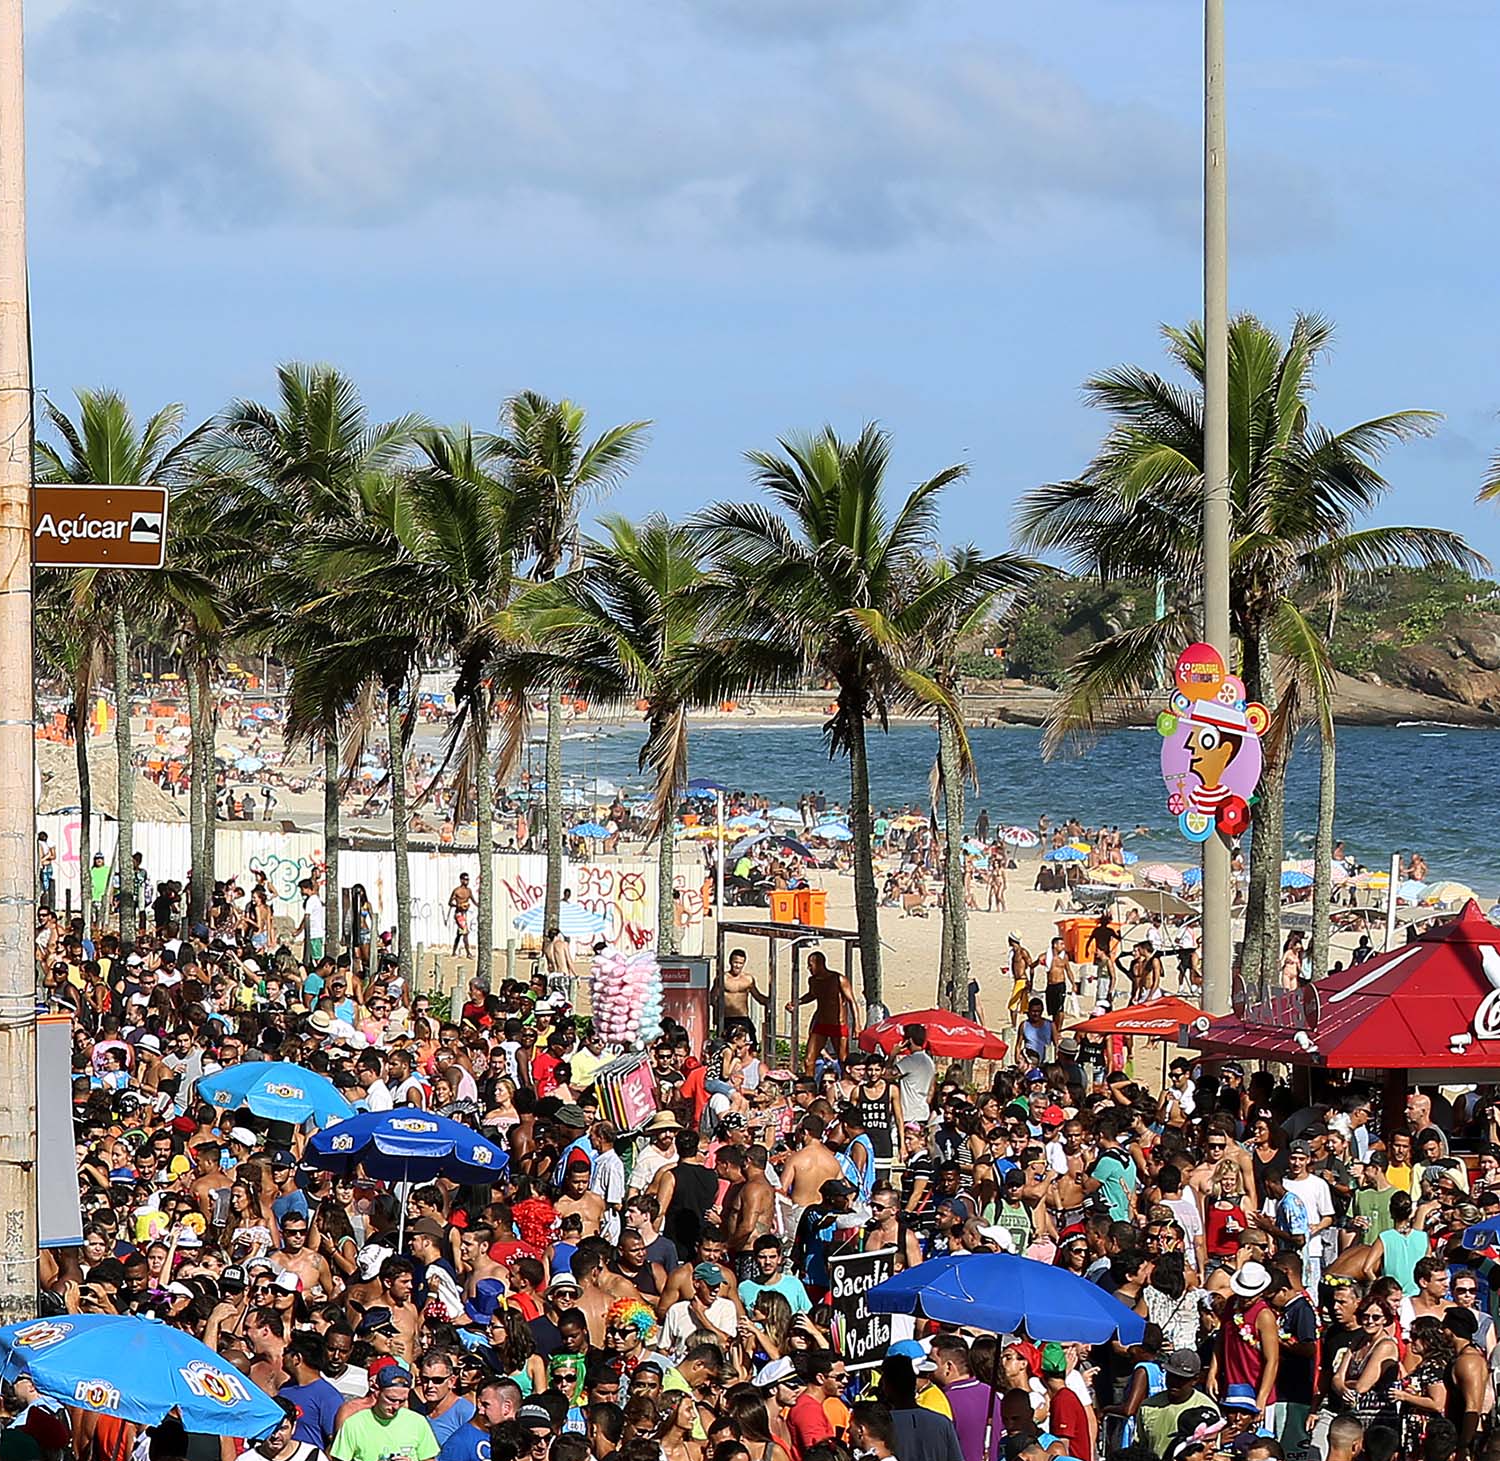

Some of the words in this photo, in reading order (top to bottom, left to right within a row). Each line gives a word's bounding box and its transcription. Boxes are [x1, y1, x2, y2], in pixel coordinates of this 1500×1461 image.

[34, 512, 128, 545] Açúcar
[832, 1260, 890, 1298] Sacolé
[845, 1317, 890, 1359] Vodka
[74, 1380, 121, 1411] BOA
[178, 1367, 252, 1402] BOA
